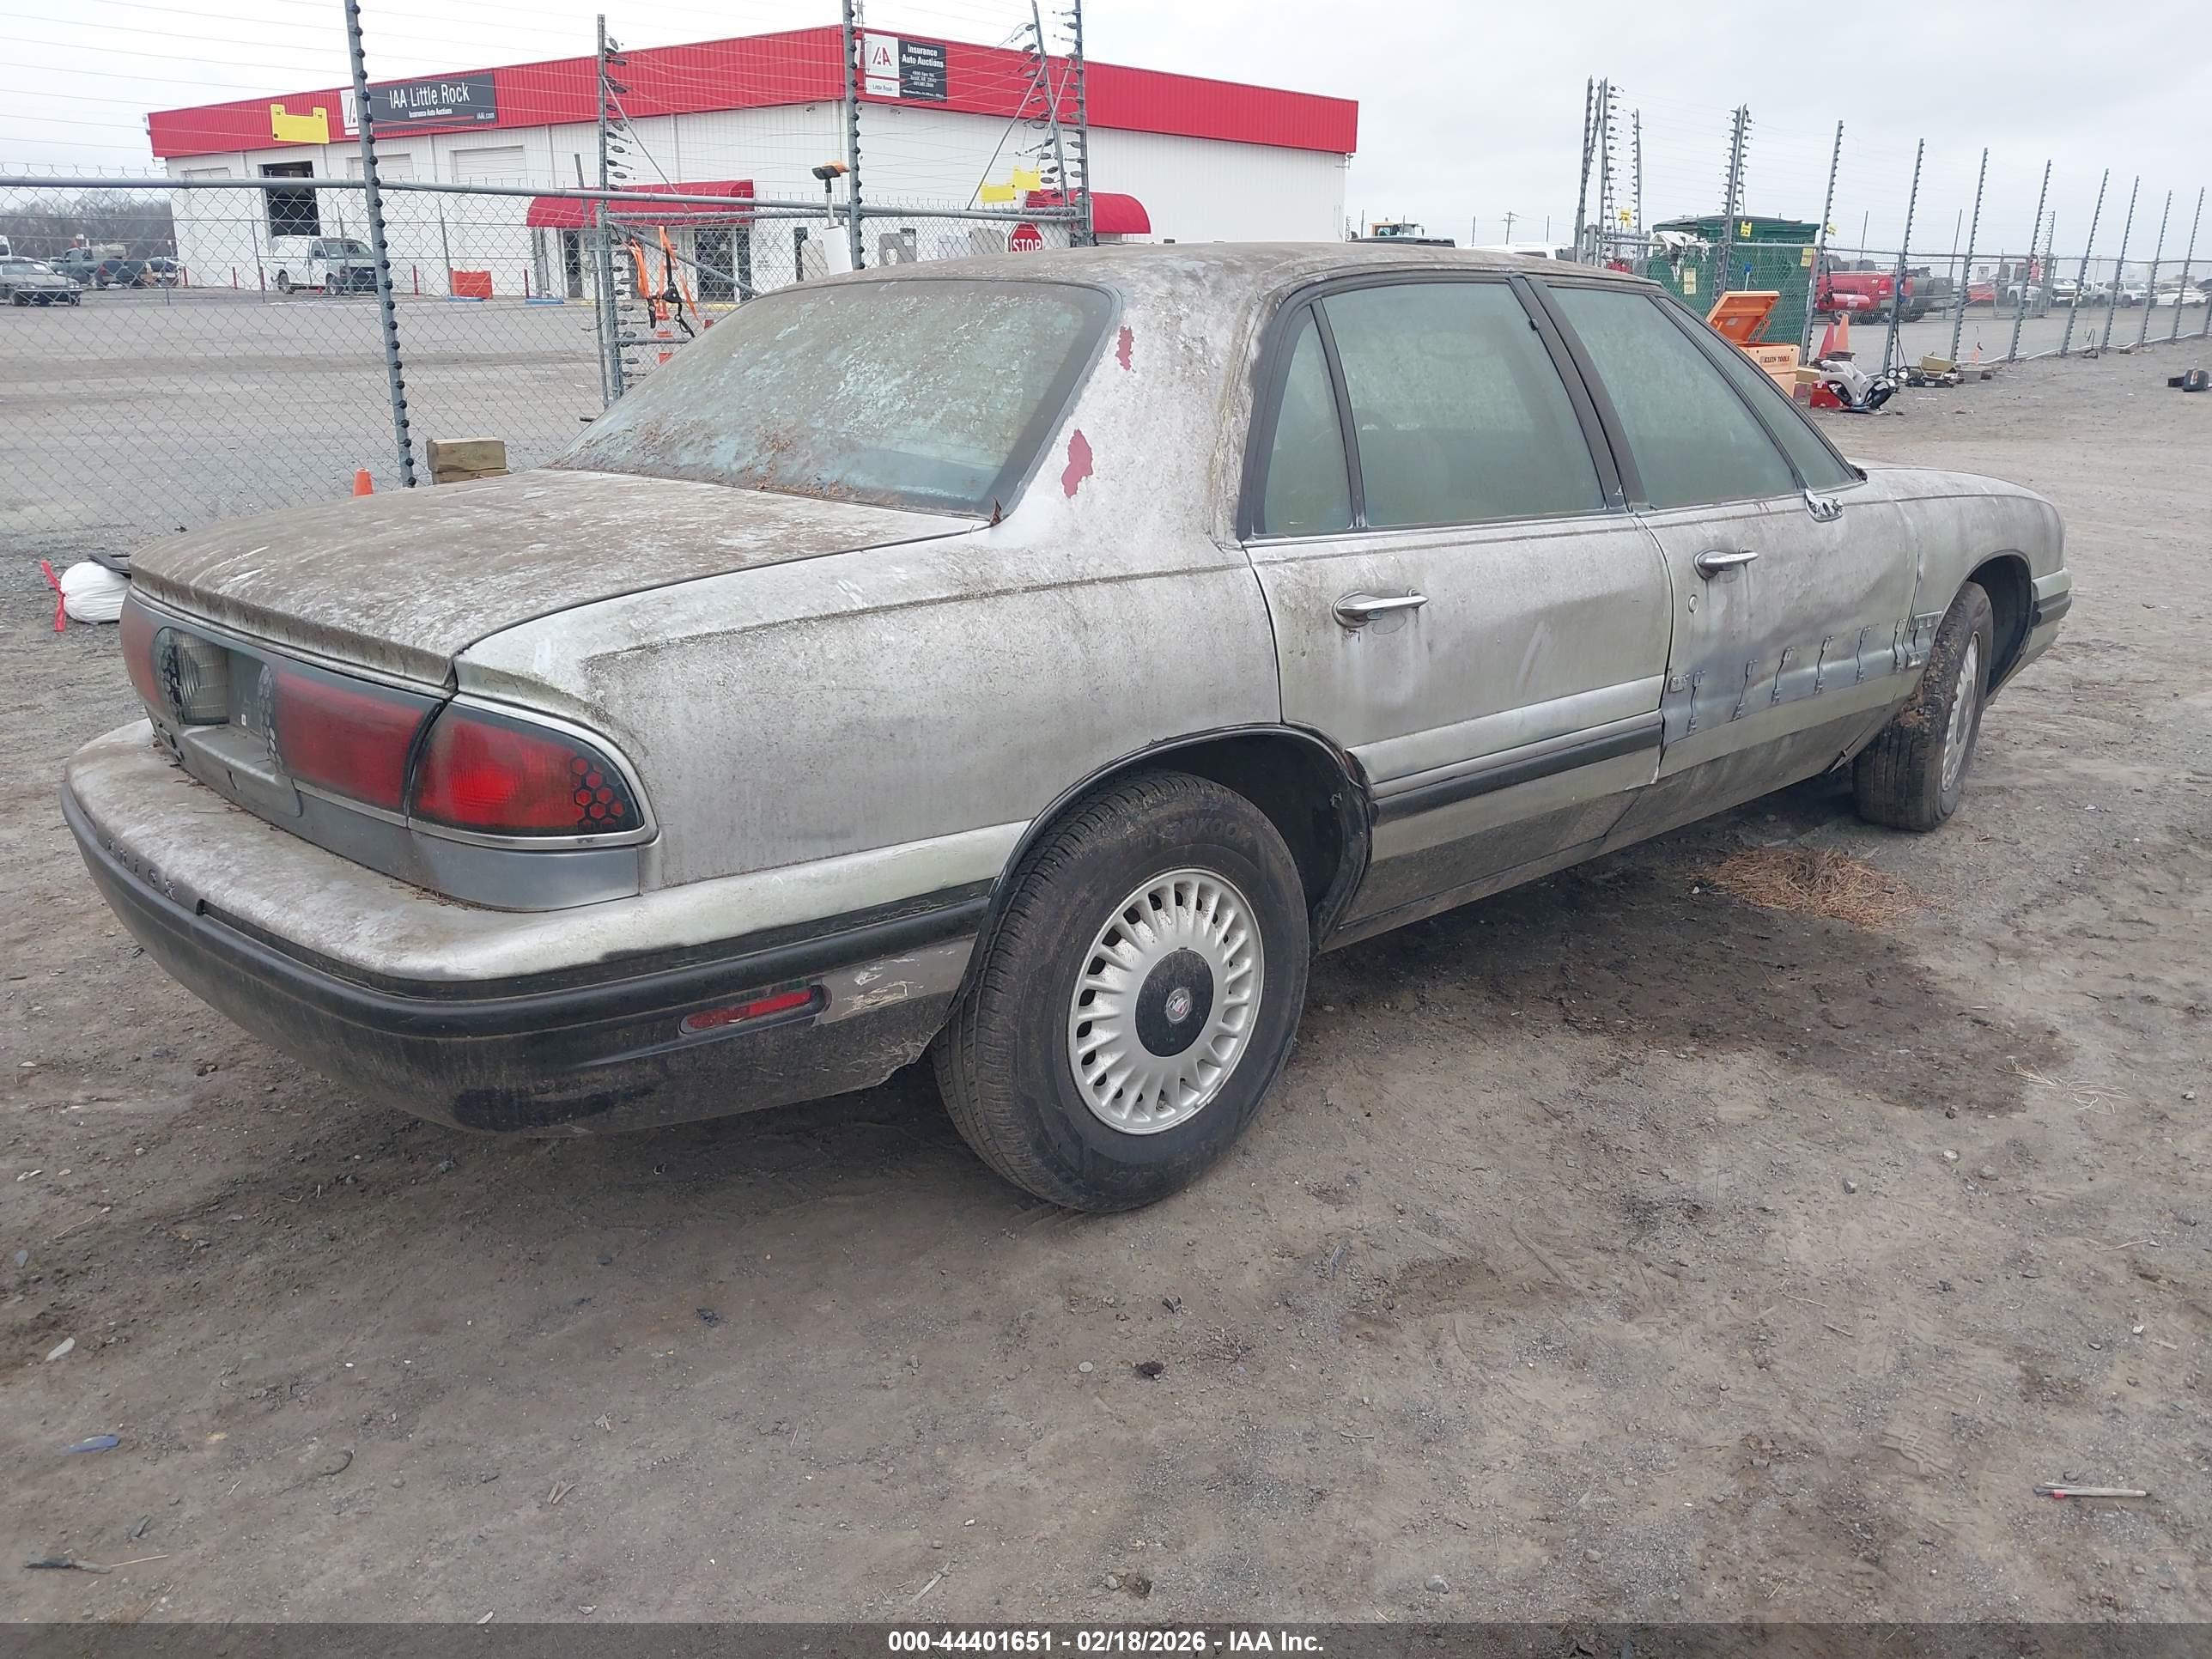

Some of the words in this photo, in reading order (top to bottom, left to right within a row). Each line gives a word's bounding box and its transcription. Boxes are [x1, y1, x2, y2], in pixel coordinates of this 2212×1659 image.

[907, 44, 938, 56] Insurance
[902, 53, 917, 64] Auto
[917, 56, 944, 69] Auctions
[389, 89, 408, 109] IAA
[410, 86, 439, 107] Little
[441, 82, 471, 104] Rock
[1012, 238, 1042, 253] STOP
